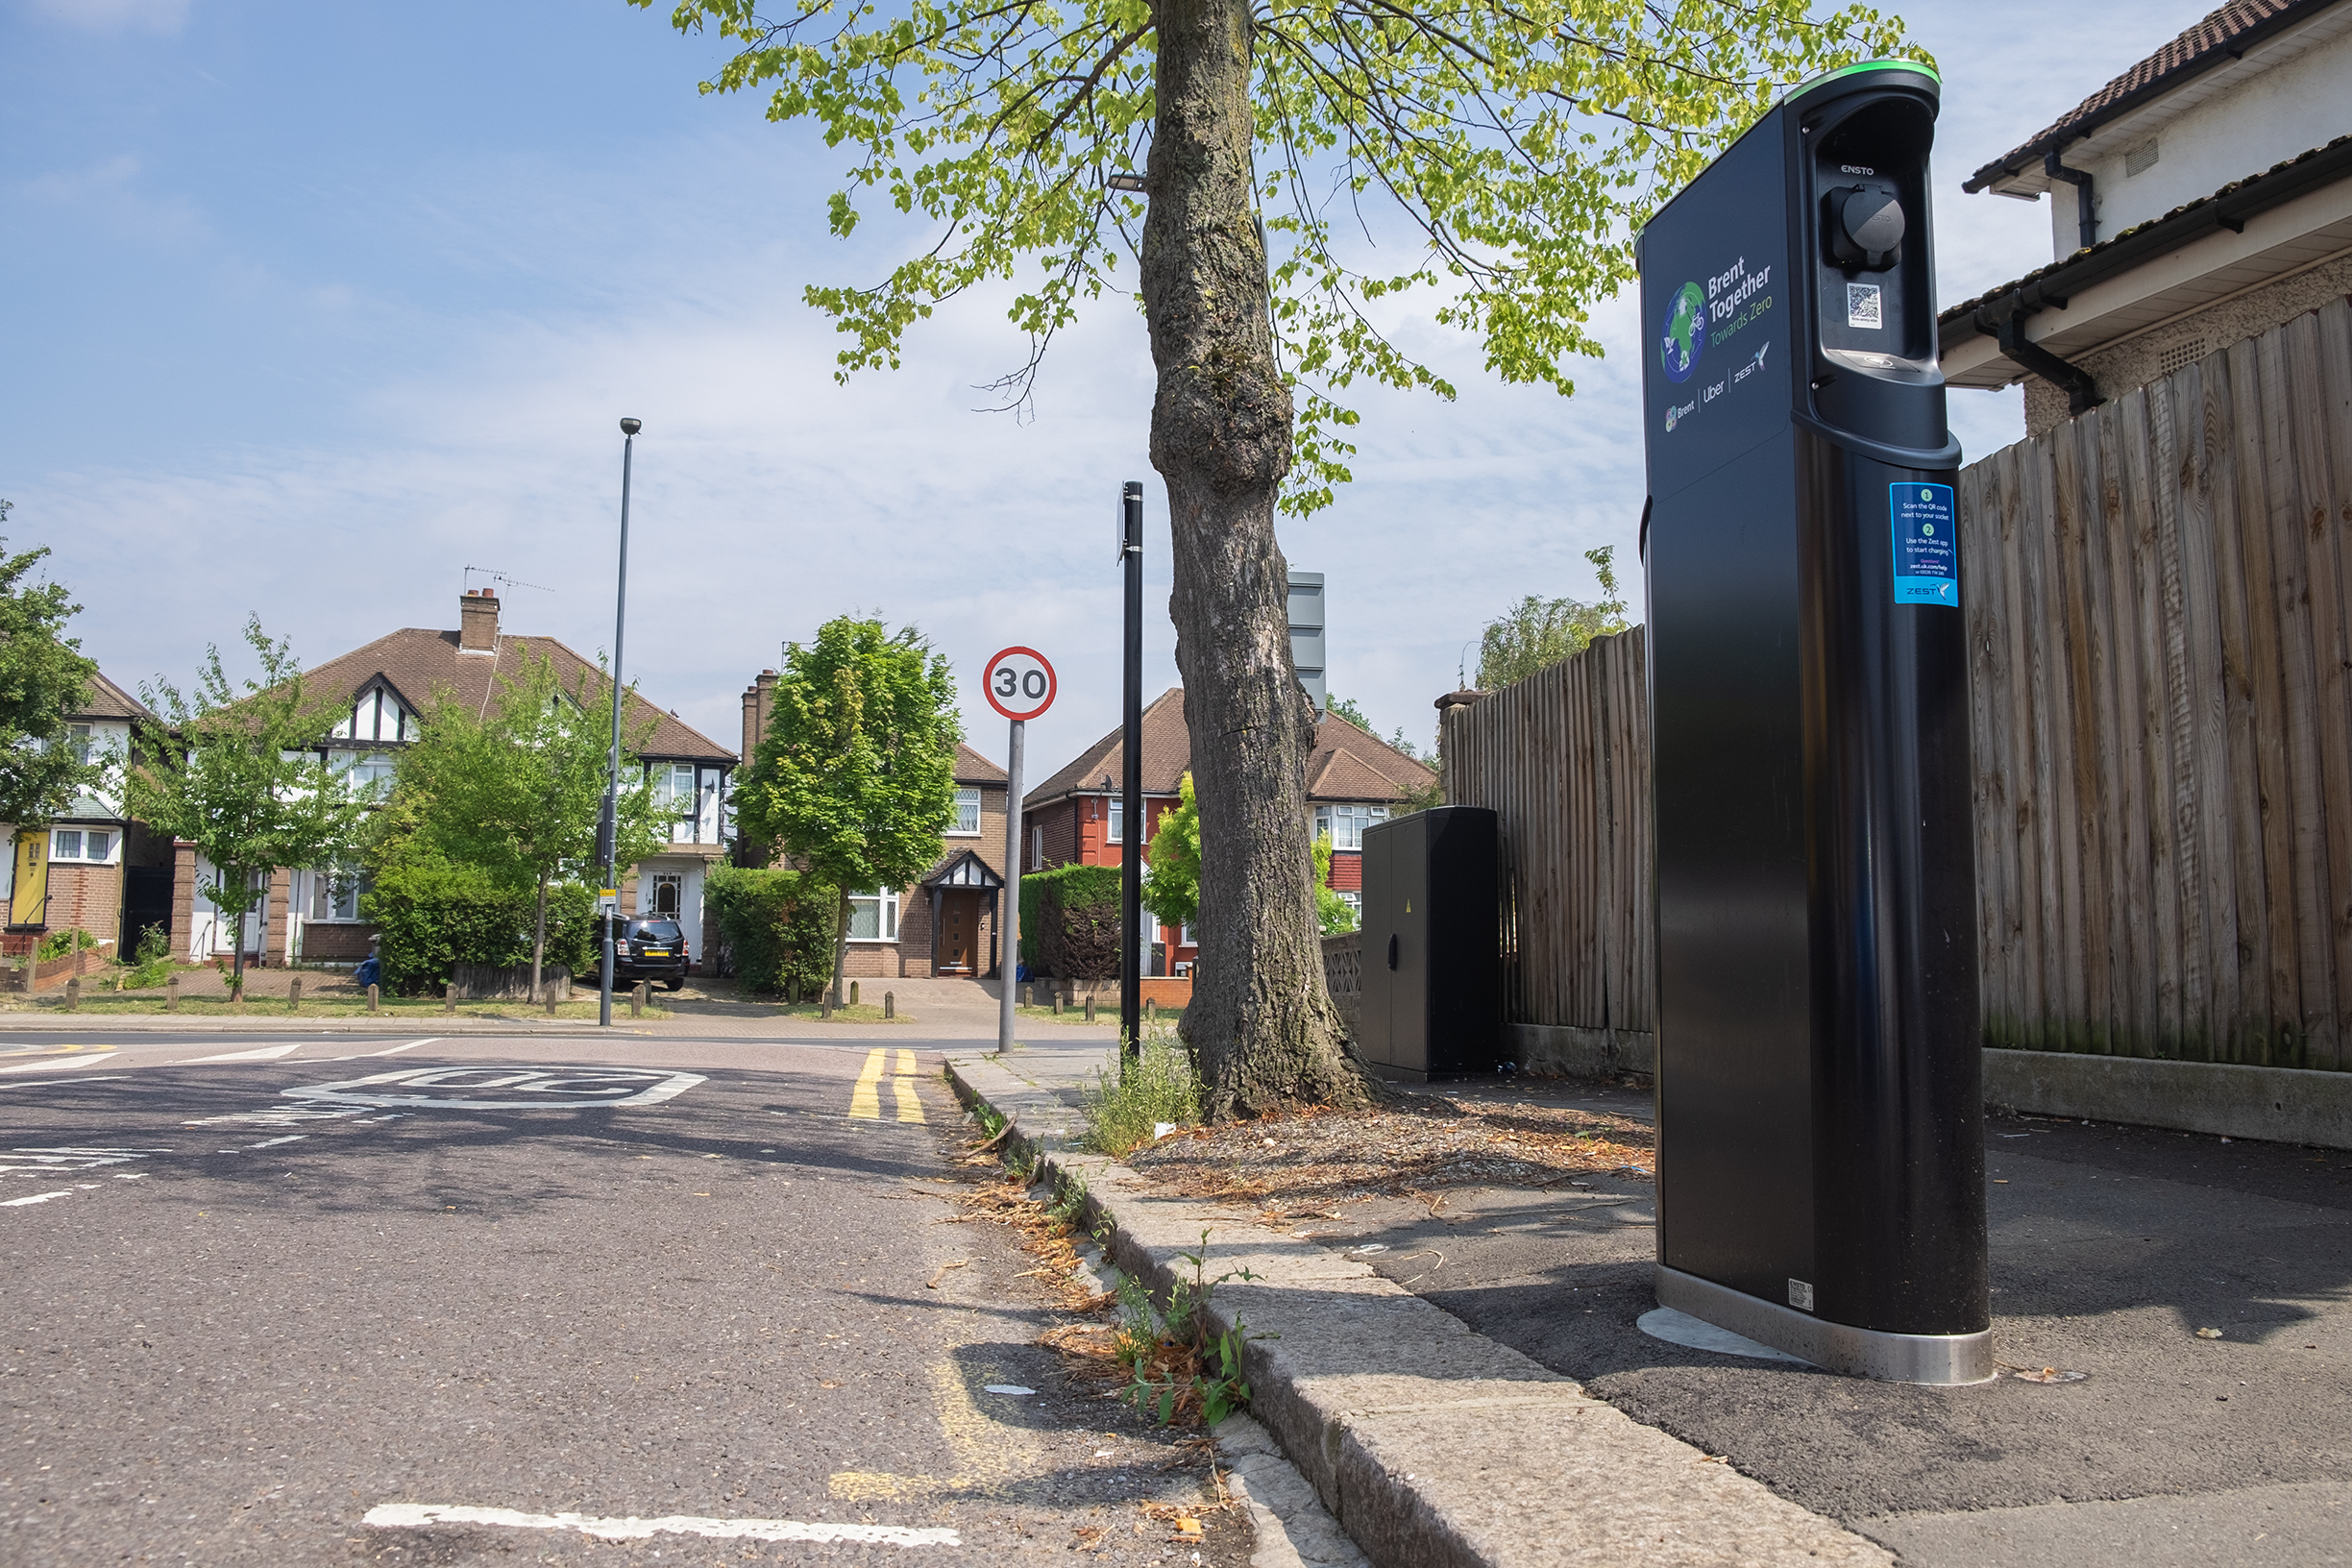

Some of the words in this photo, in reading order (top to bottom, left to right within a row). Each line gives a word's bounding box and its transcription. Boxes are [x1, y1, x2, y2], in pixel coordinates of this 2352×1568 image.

[1841, 164, 1874, 176] ENSTO
[1708, 256, 1745, 300] Brent
[1709, 264, 1771, 323] Together
[1710, 311, 1748, 348] Towards
[1750, 295, 1773, 321] Zero
[1678, 400, 1694, 419] Brent
[1703, 380, 1725, 403] Uber
[1734, 361, 1756, 383] ZEST
[1928, 548, 1948, 556] charging
[1907, 587, 1936, 596] ZEST
[994, 668, 1046, 699] 30
